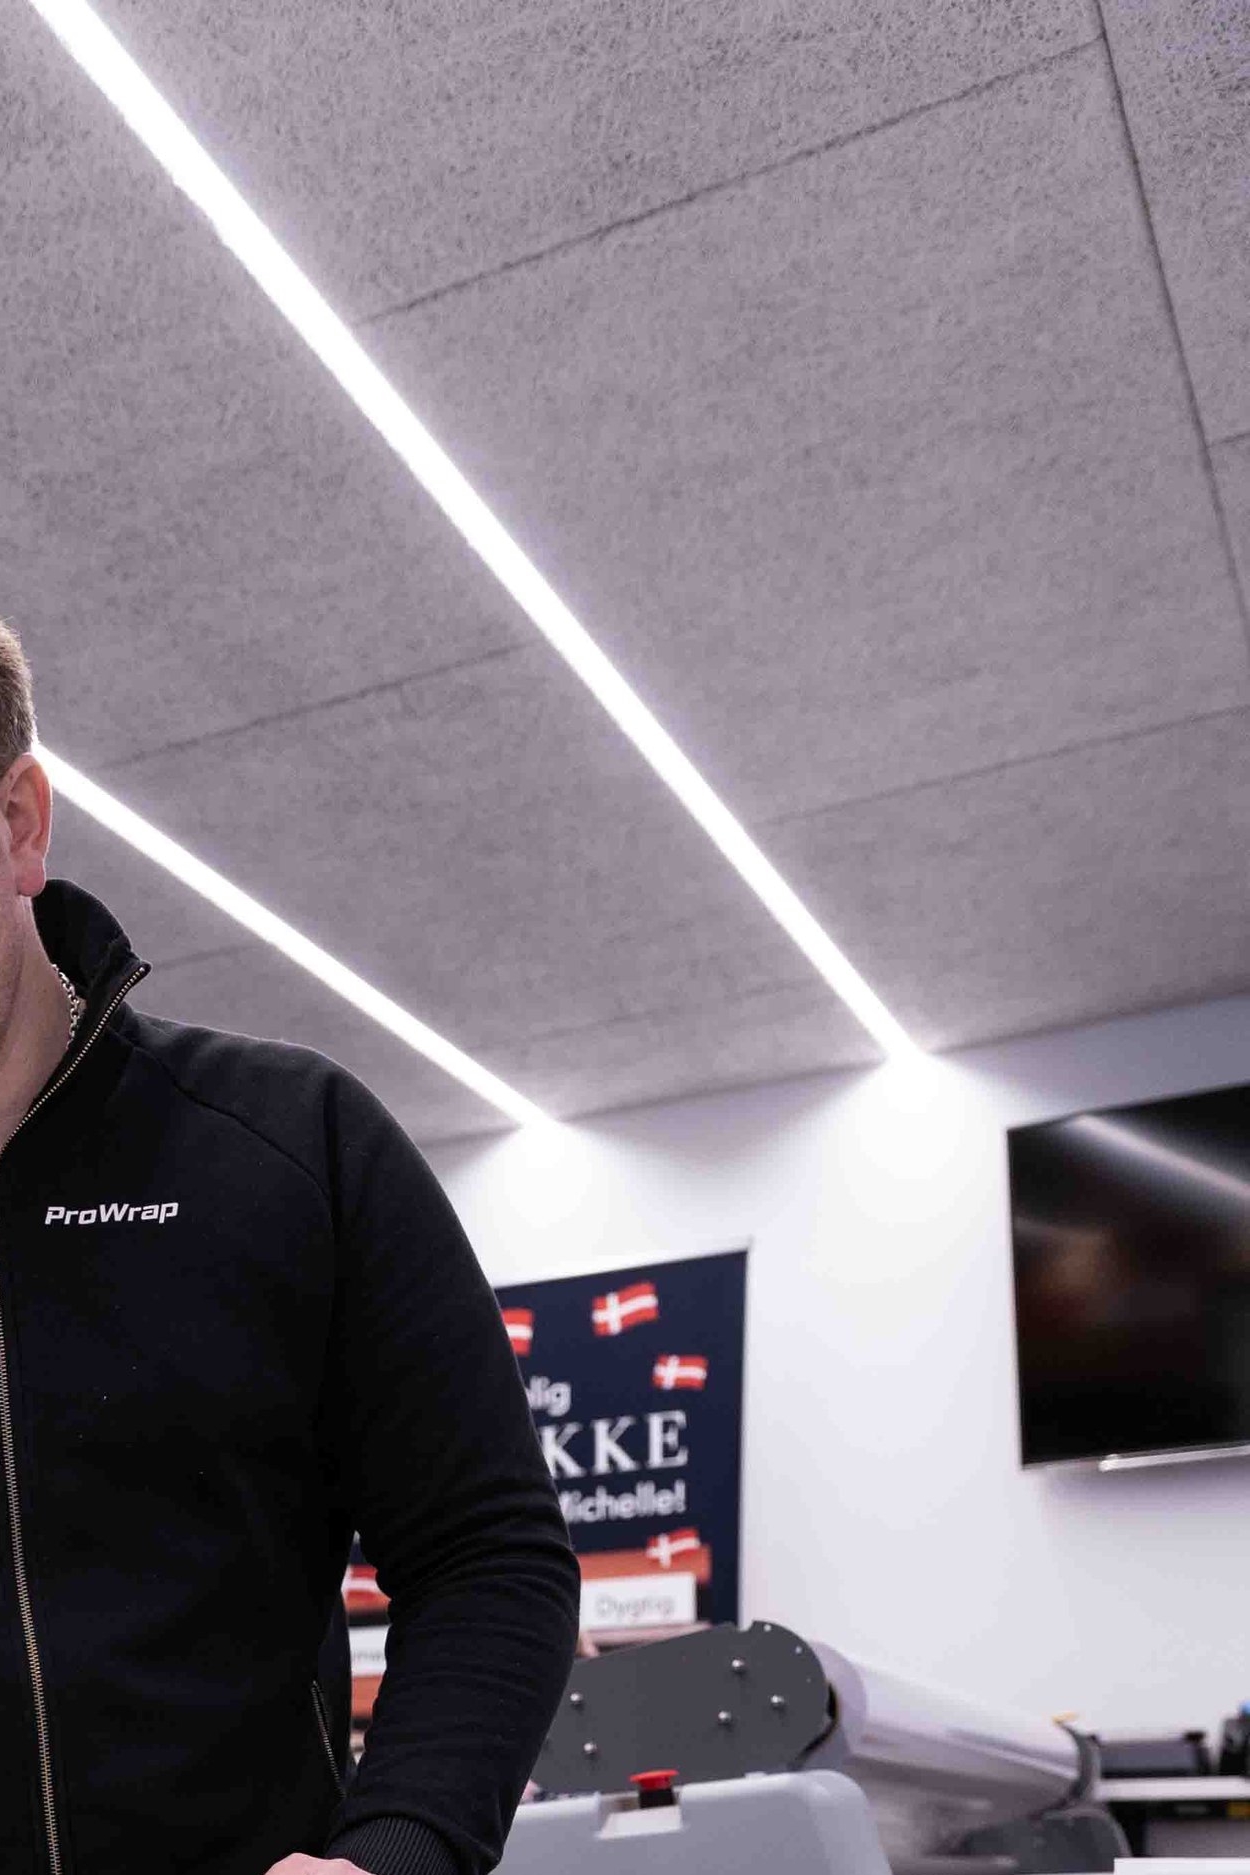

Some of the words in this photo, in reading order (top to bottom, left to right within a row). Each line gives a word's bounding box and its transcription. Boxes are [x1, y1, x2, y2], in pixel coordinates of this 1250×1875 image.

[45, 1202, 179, 1225] ProWrap
[525, 1375, 572, 1417] lig
[539, 1409, 689, 1479] KKE
